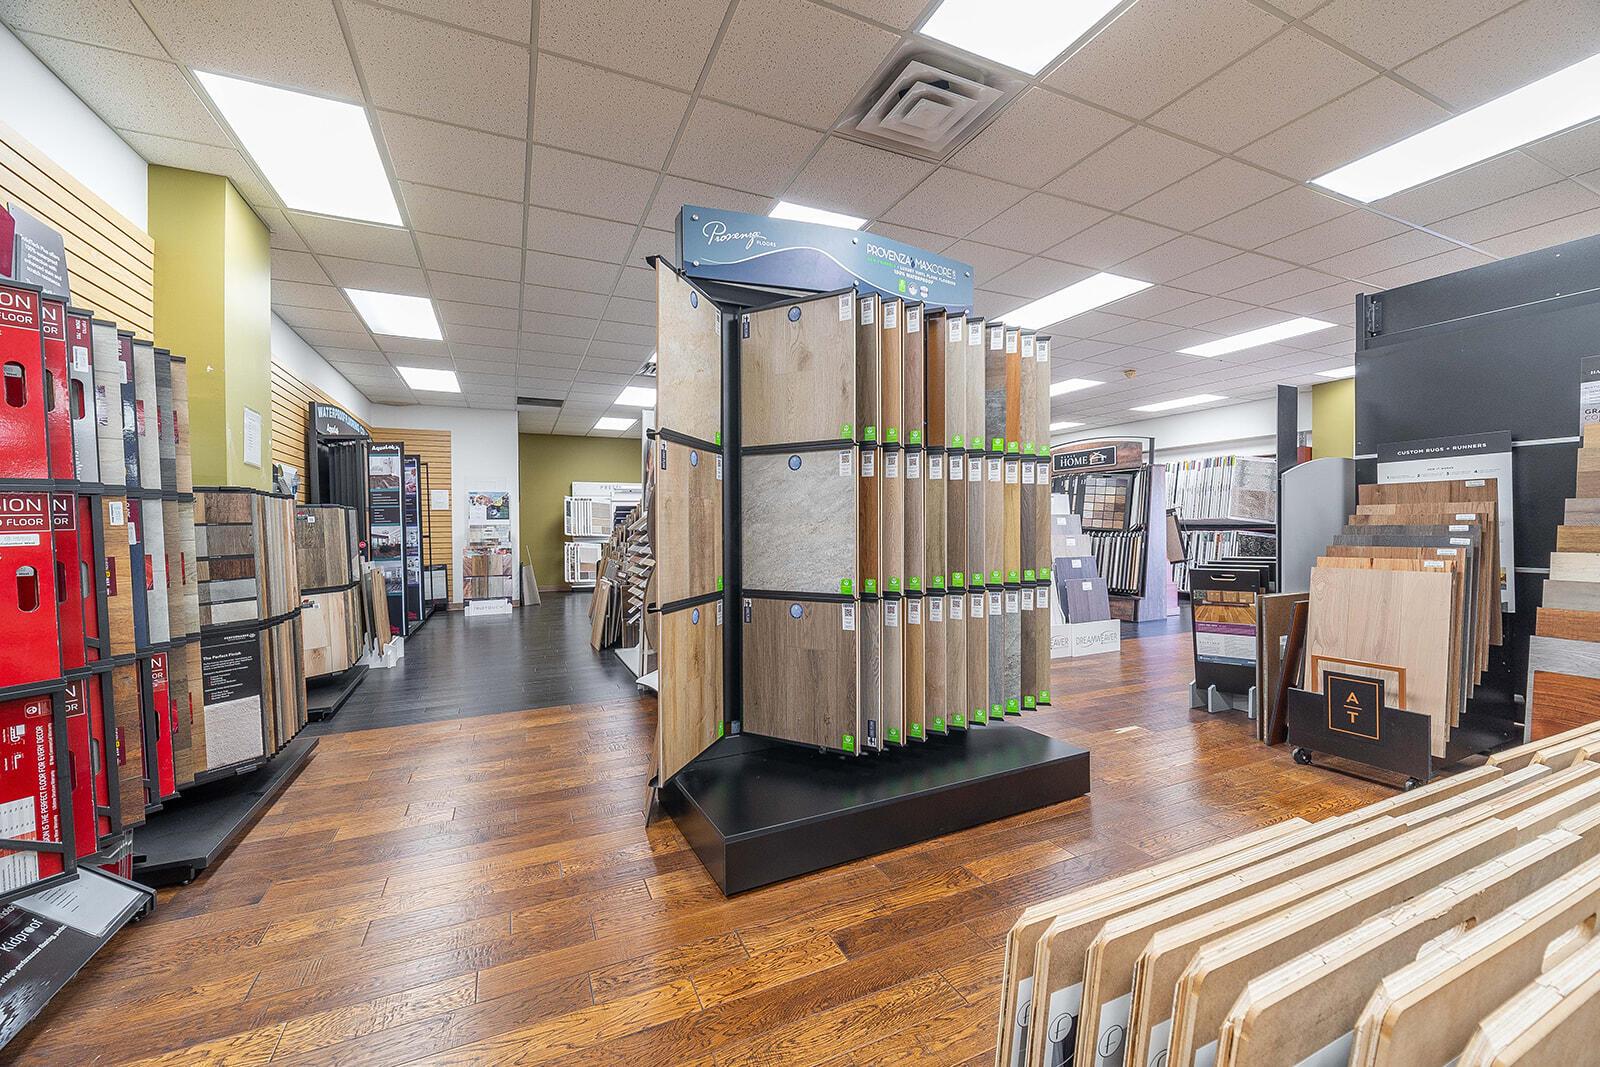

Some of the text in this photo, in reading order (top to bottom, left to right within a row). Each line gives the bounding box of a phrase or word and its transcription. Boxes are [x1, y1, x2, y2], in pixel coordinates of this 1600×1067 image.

[702, 220, 767, 250] Provenza
[866, 243, 911, 267] PROVENZA
[915, 258, 952, 279] MAXCORE
[0, 311, 33, 324] LOOR
[317, 406, 347, 423] WATERPROOF
[1397, 448, 1424, 456] CUSTOM
[1452, 442, 1487, 451] RUNNERS
[1060, 456, 1088, 467] HOME
[0, 498, 42, 511] ION
[6, 518, 44, 527] FLOOR
[1346, 691, 1359, 705] A
[1347, 711, 1359, 724] T
[35, 725, 44, 743] DECOR
[36, 744, 45, 761] EVERY
[38, 761, 46, 773] FOR
[39, 773, 47, 791] FLOOR
[40, 791, 49, 813] PERFECT
[41, 813, 49, 825] THE
[0, 918, 43, 952] Kidproof
